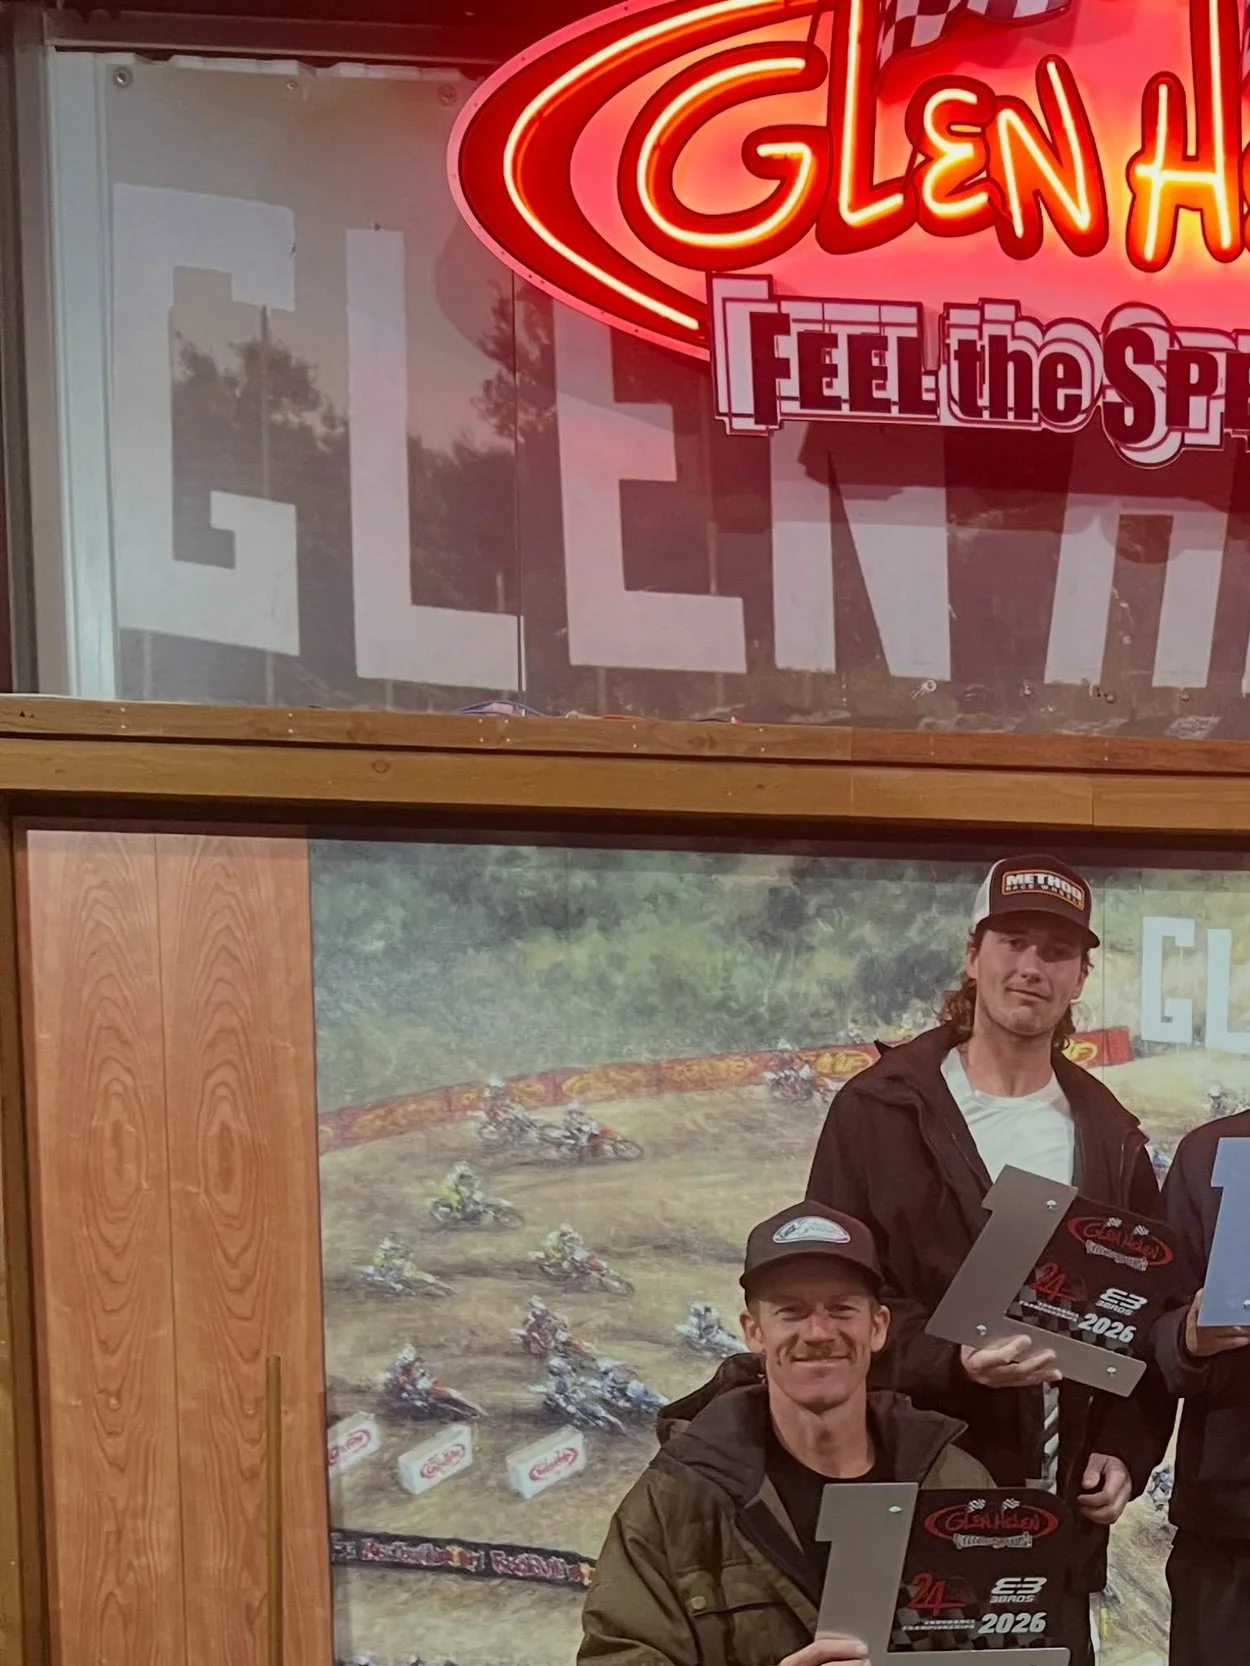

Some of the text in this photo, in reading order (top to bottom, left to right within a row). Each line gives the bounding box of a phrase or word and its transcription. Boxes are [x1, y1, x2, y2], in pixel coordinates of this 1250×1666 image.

[618, 0, 1107, 269] GLEN
[749, 311, 939, 426] FEEL
[952, 334, 1083, 421] the
[1006, 873, 1082, 901] METHOD
[1078, 1312, 1137, 1343] 2026
[944, 1508, 991, 1532] GLEN
[906, 1572, 967, 1617] 24
[977, 1612, 1048, 1635] 2026
